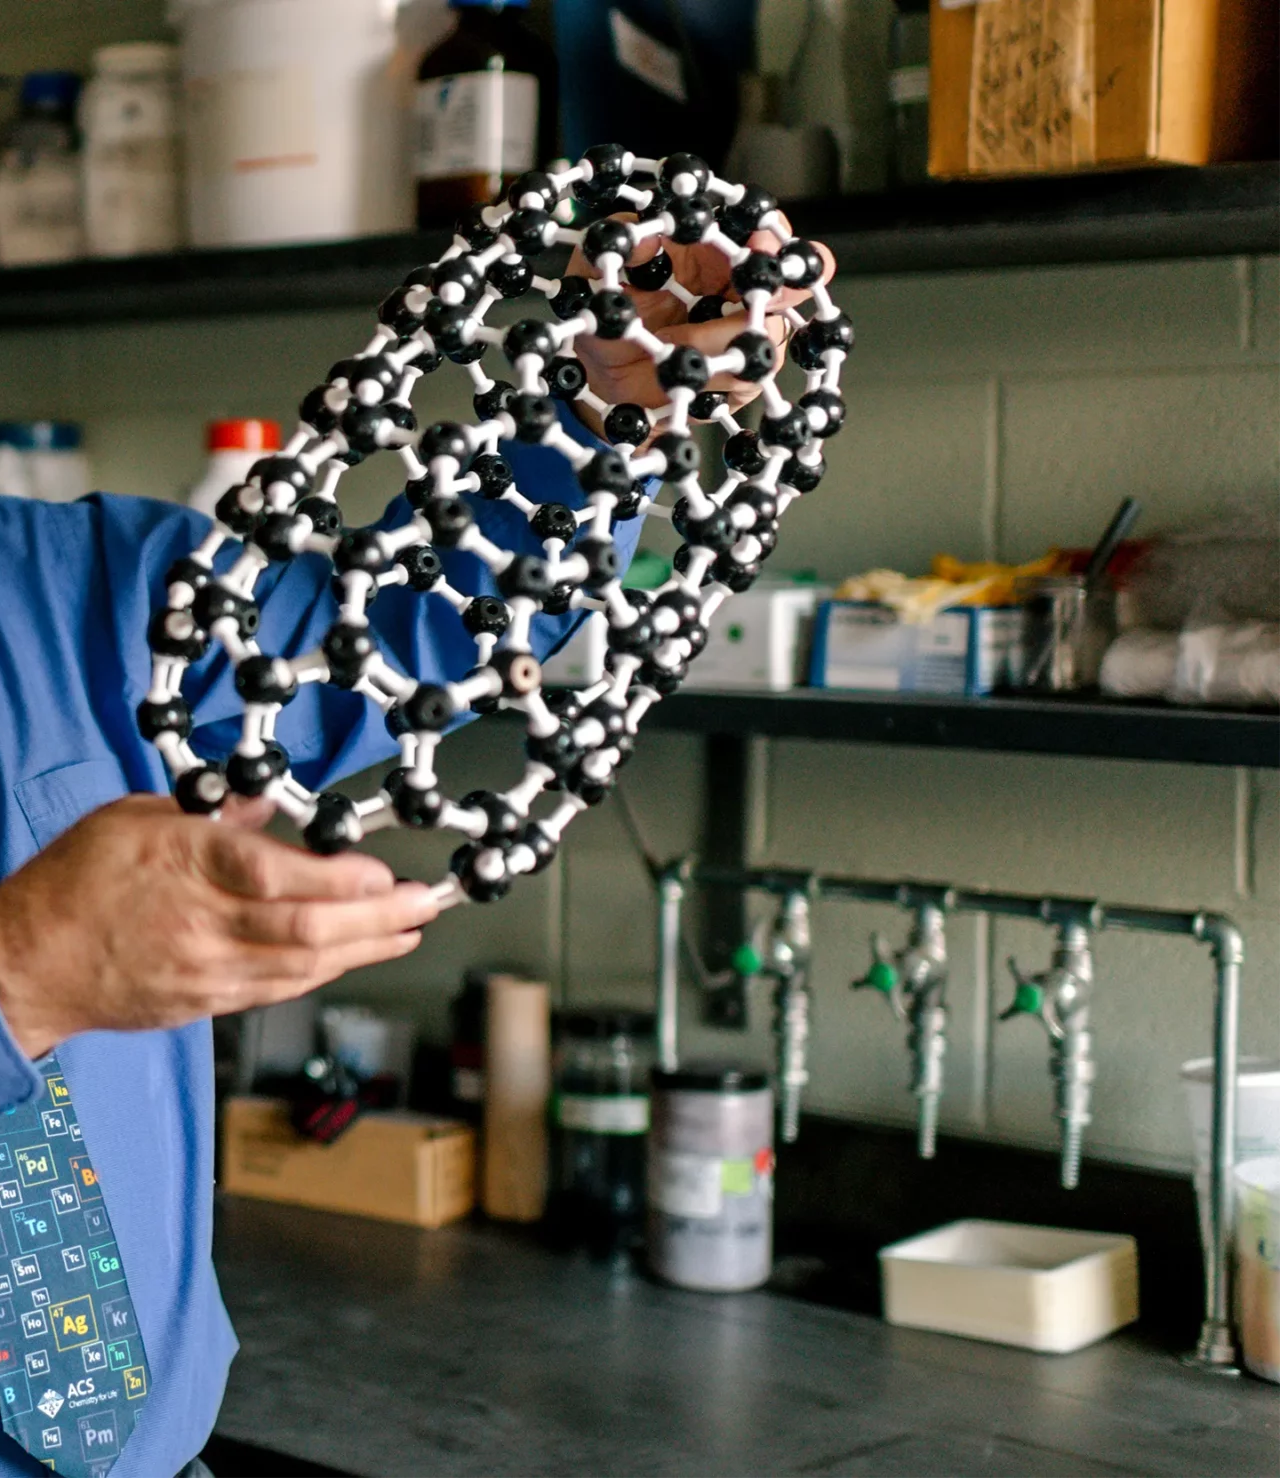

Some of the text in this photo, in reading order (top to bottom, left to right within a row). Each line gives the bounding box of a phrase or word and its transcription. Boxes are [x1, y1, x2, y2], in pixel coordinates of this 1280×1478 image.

[49, 1118, 61, 1129] Fe
[19, 1152, 29, 1161] 46
[25, 1156, 48, 1175] Pd
[2, 1189, 17, 1200] Ru
[58, 1193, 73, 1205] Yb
[14, 1212, 26, 1222] 52
[92, 1216, 100, 1226] U
[24, 1218, 47, 1236] Te
[91, 1251, 101, 1260] 31
[17, 1264, 36, 1276] Sm
[99, 1257, 120, 1273] Ga
[53, 1308, 64, 1317] 47
[27, 1319, 42, 1329] Ho
[63, 1314, 89, 1335] Ag
[112, 1311, 128, 1327] Kr
[88, 1351, 101, 1363] Xe
[114, 1350, 125, 1361] In
[31, 1359, 44, 1369] Eu
[67, 1377, 95, 1399] ACS
[130, 1377, 142, 1389] Zn
[4, 1386, 16, 1404] B
[85, 1428, 113, 1446] Pm
